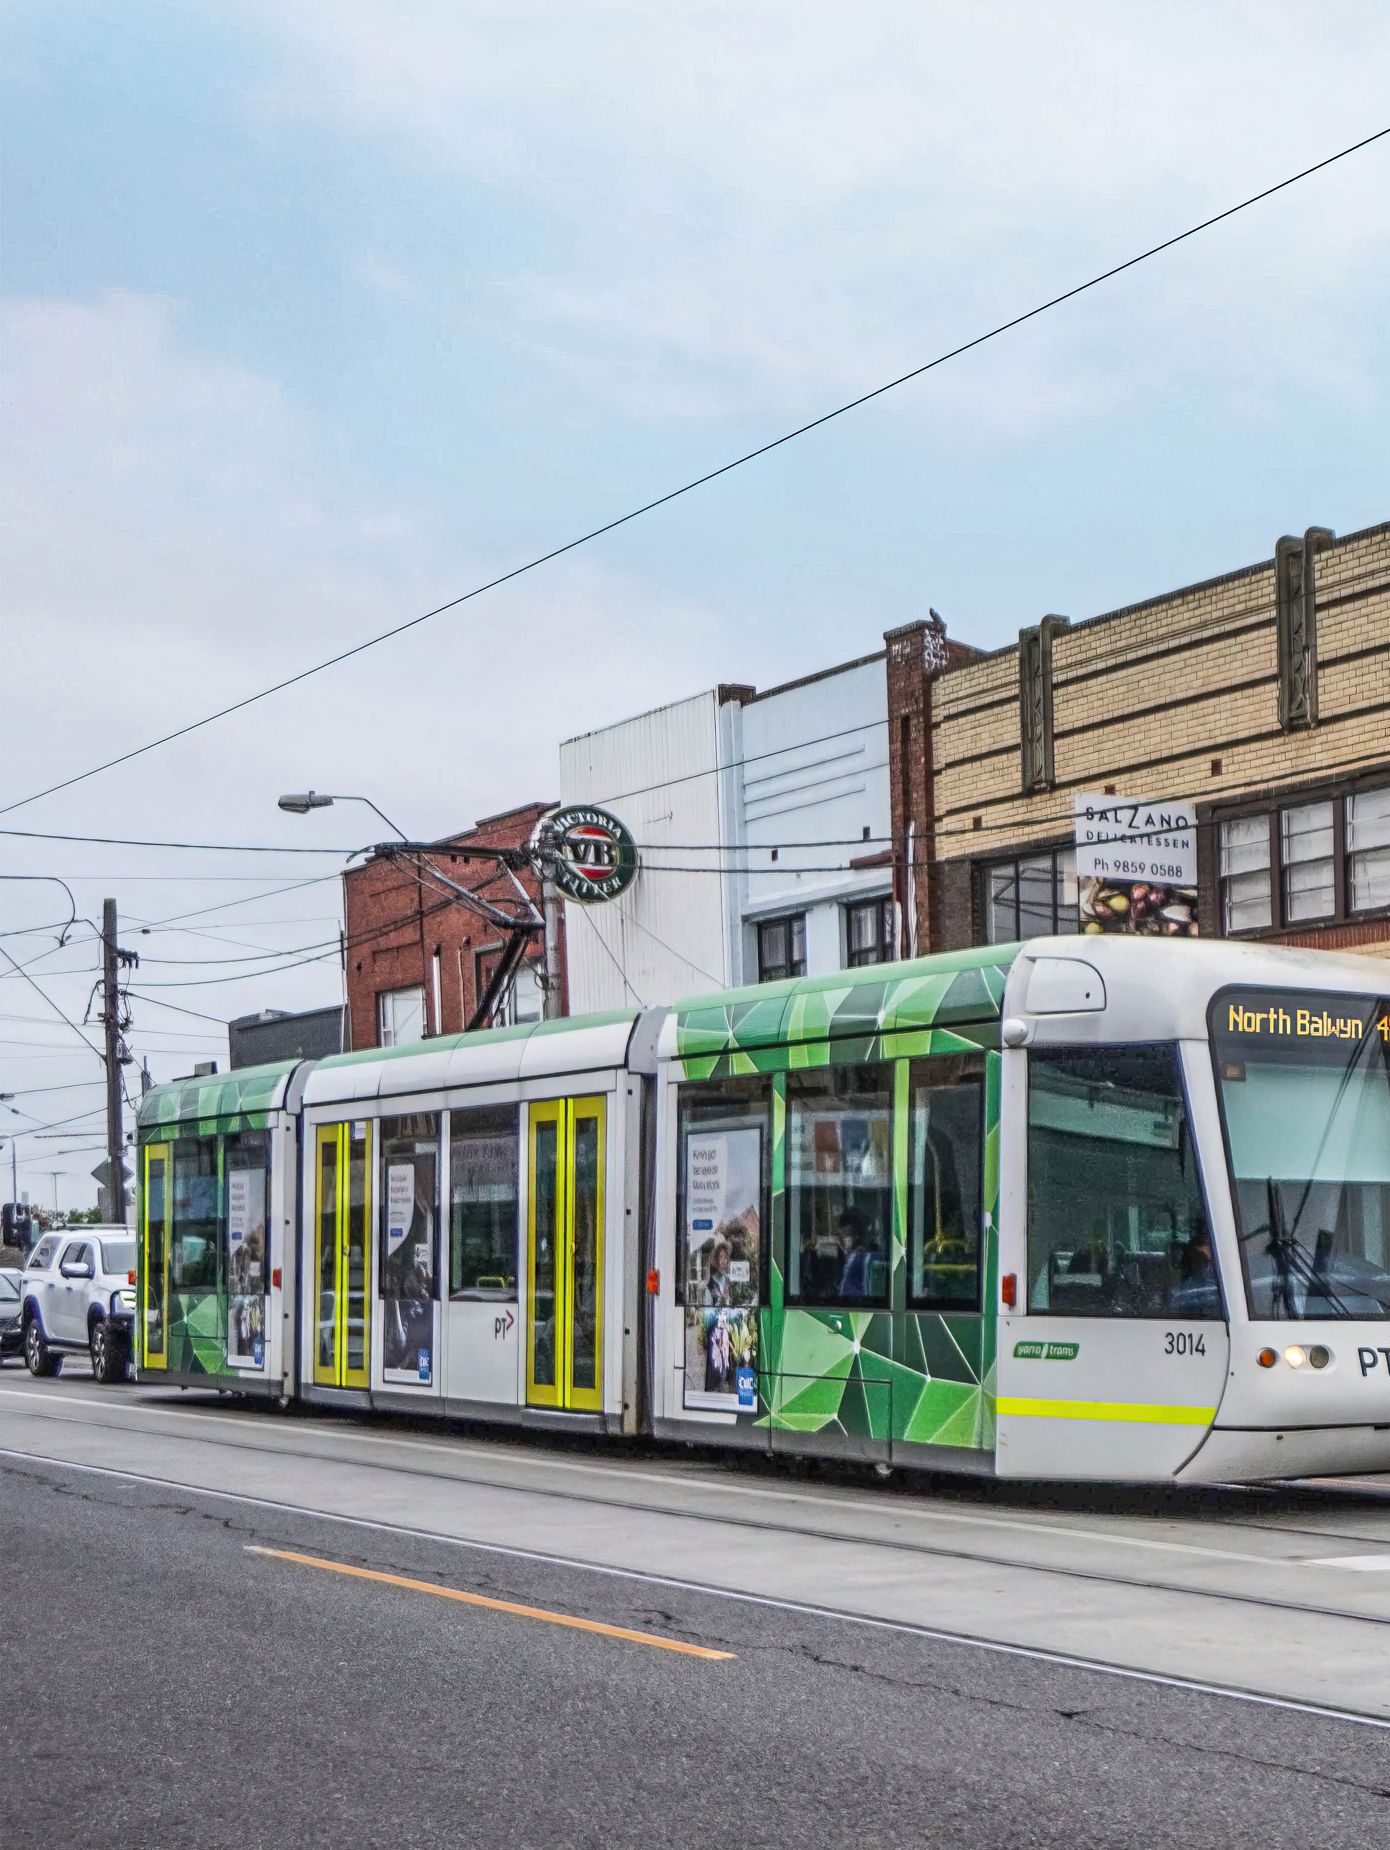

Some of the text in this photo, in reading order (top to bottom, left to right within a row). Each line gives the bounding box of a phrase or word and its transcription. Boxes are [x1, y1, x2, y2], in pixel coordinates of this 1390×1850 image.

[553, 811, 622, 838] VICTORIA
[1086, 806, 1189, 829] SALZANO
[1087, 830, 1190, 849] DELICATESSEN
[562, 842, 619, 865] VB
[1094, 858, 1183, 878] Ph 9859 0588
[1228, 1004, 1363, 1039] North Balwyn
[1164, 1332, 1206, 1356] 3014
